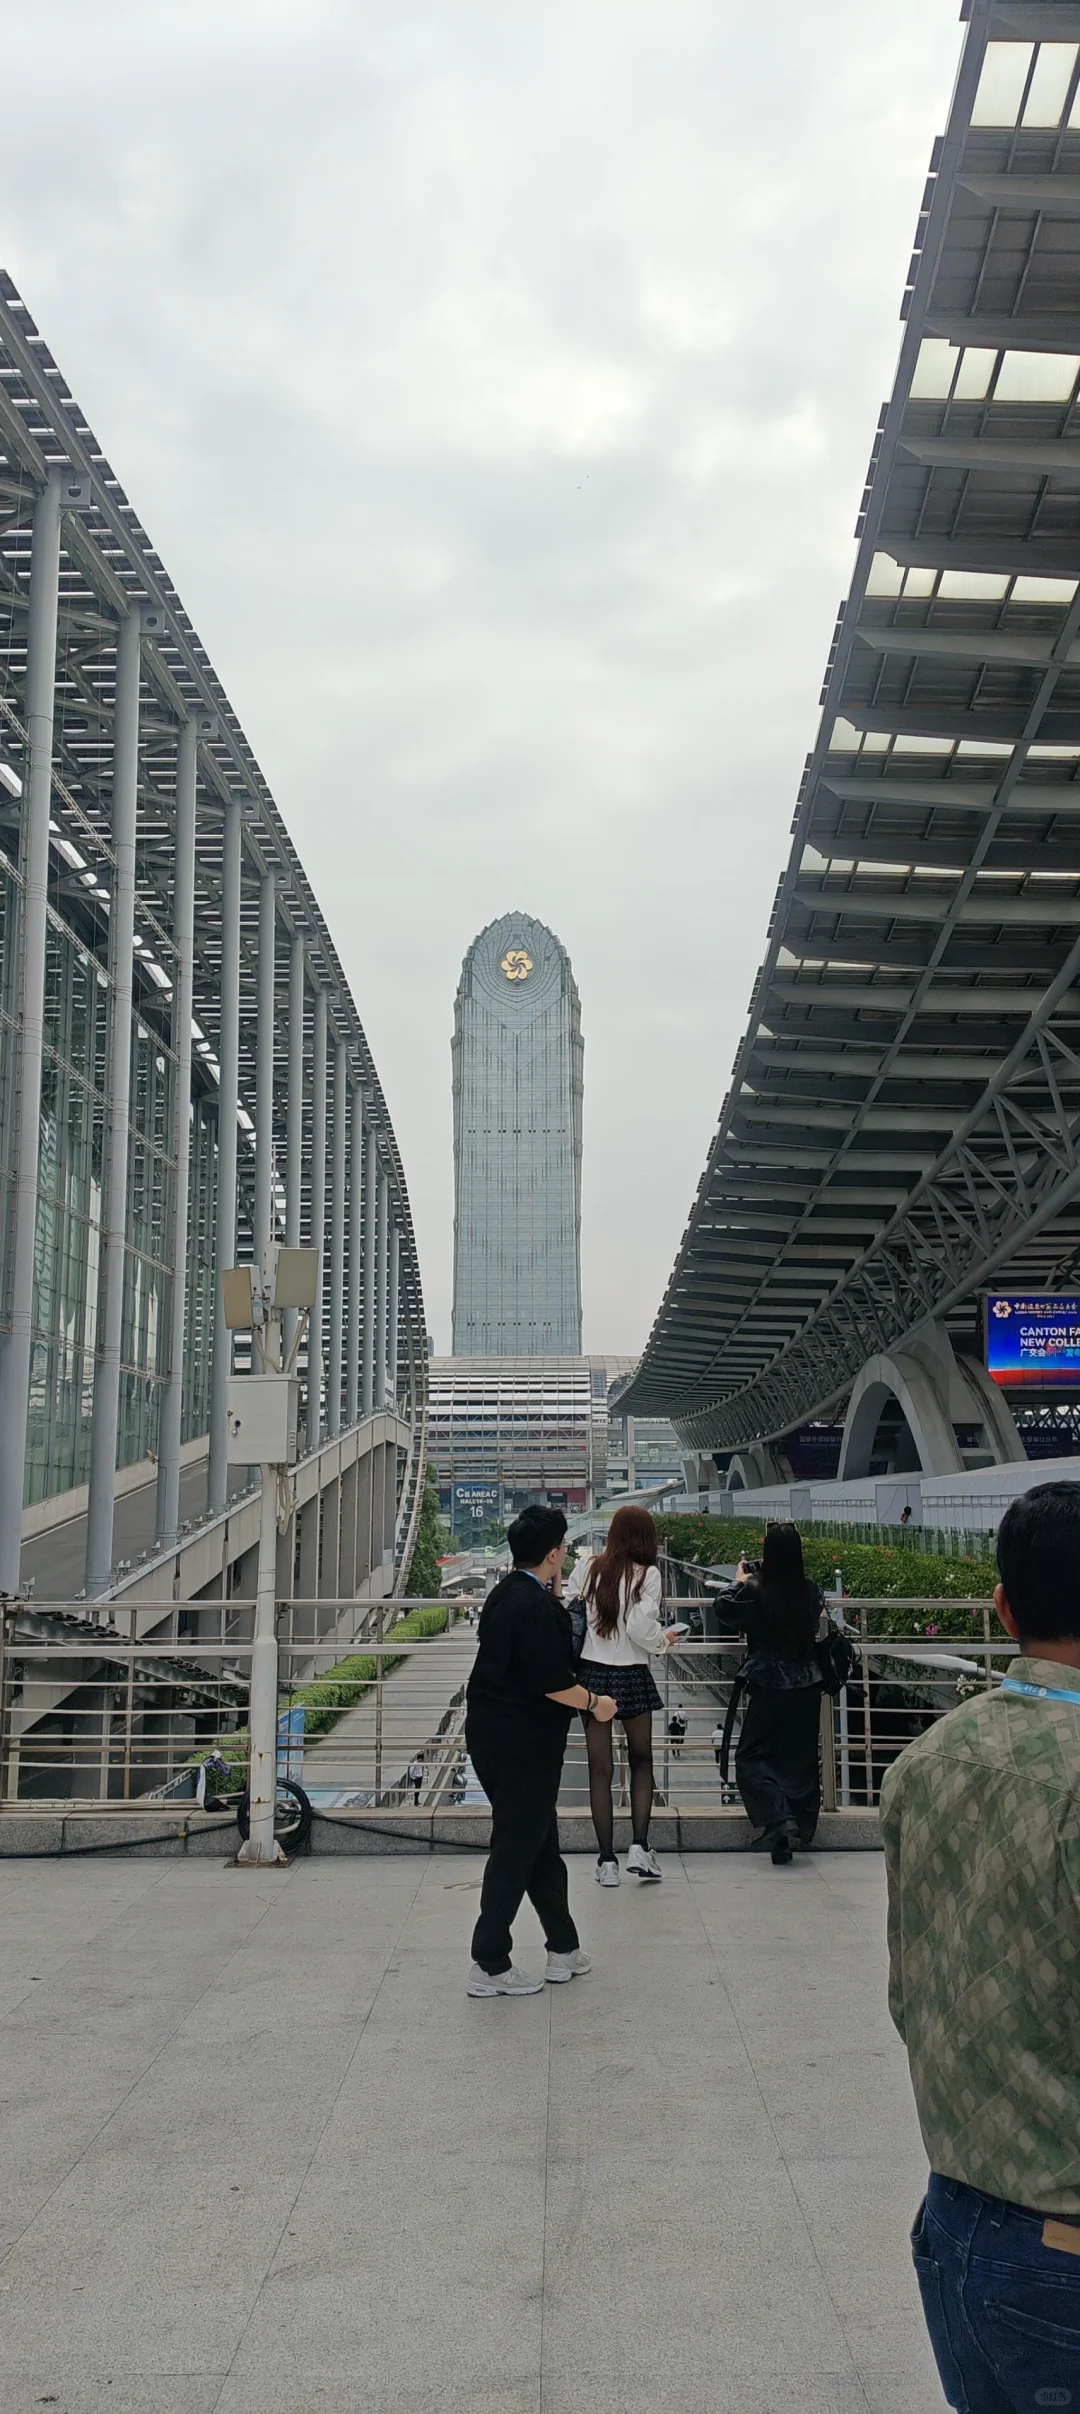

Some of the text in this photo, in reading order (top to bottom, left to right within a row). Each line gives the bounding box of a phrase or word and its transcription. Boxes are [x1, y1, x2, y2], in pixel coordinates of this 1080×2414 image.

[1020, 1327, 1066, 1336] CANTON
[1020, 1338, 1046, 1347] NEW
[470, 1506, 483, 1517] 16
